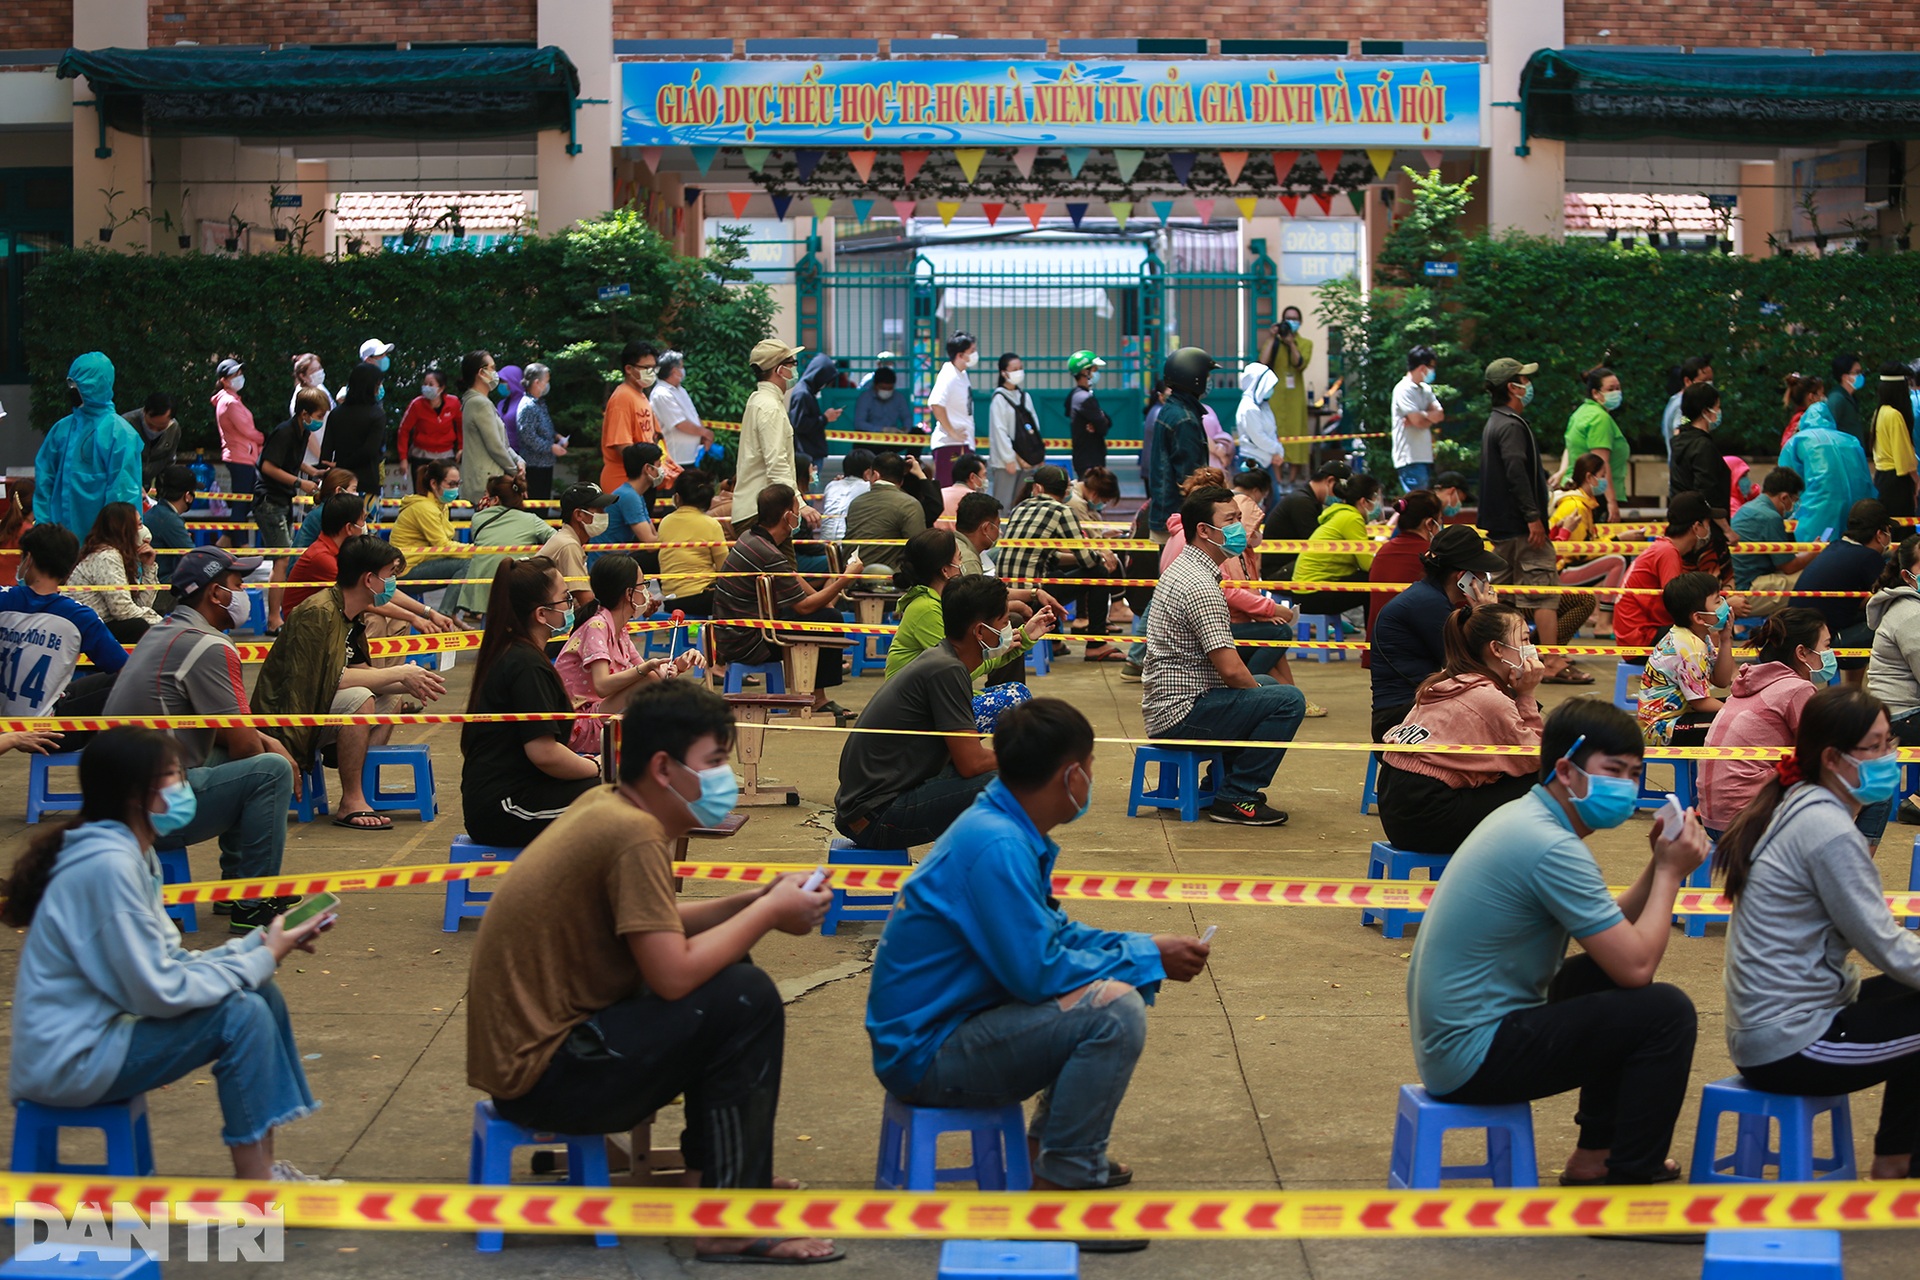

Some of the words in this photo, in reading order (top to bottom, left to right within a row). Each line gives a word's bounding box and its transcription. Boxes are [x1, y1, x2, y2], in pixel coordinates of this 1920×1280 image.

[655, 68, 719, 127] GIÁO
[723, 81, 775, 142] DỤC
[778, 63, 836, 128] TIỂU
[839, 81, 896, 142] HỌC
[994, 66, 1027, 127] LÀ
[1032, 62, 1097, 126] NIỀM
[1099, 81, 1144, 126] TIN
[1148, 66, 1196, 126] CỦA
[1200, 81, 1247, 126] GIA
[1251, 68, 1317, 127] ĐÌNH
[1319, 68, 1352, 126] VÀ
[1359, 70, 1395, 126] XÃ
[1399, 70, 1447, 142] HỘI
[47, 632, 62, 651] Bé
